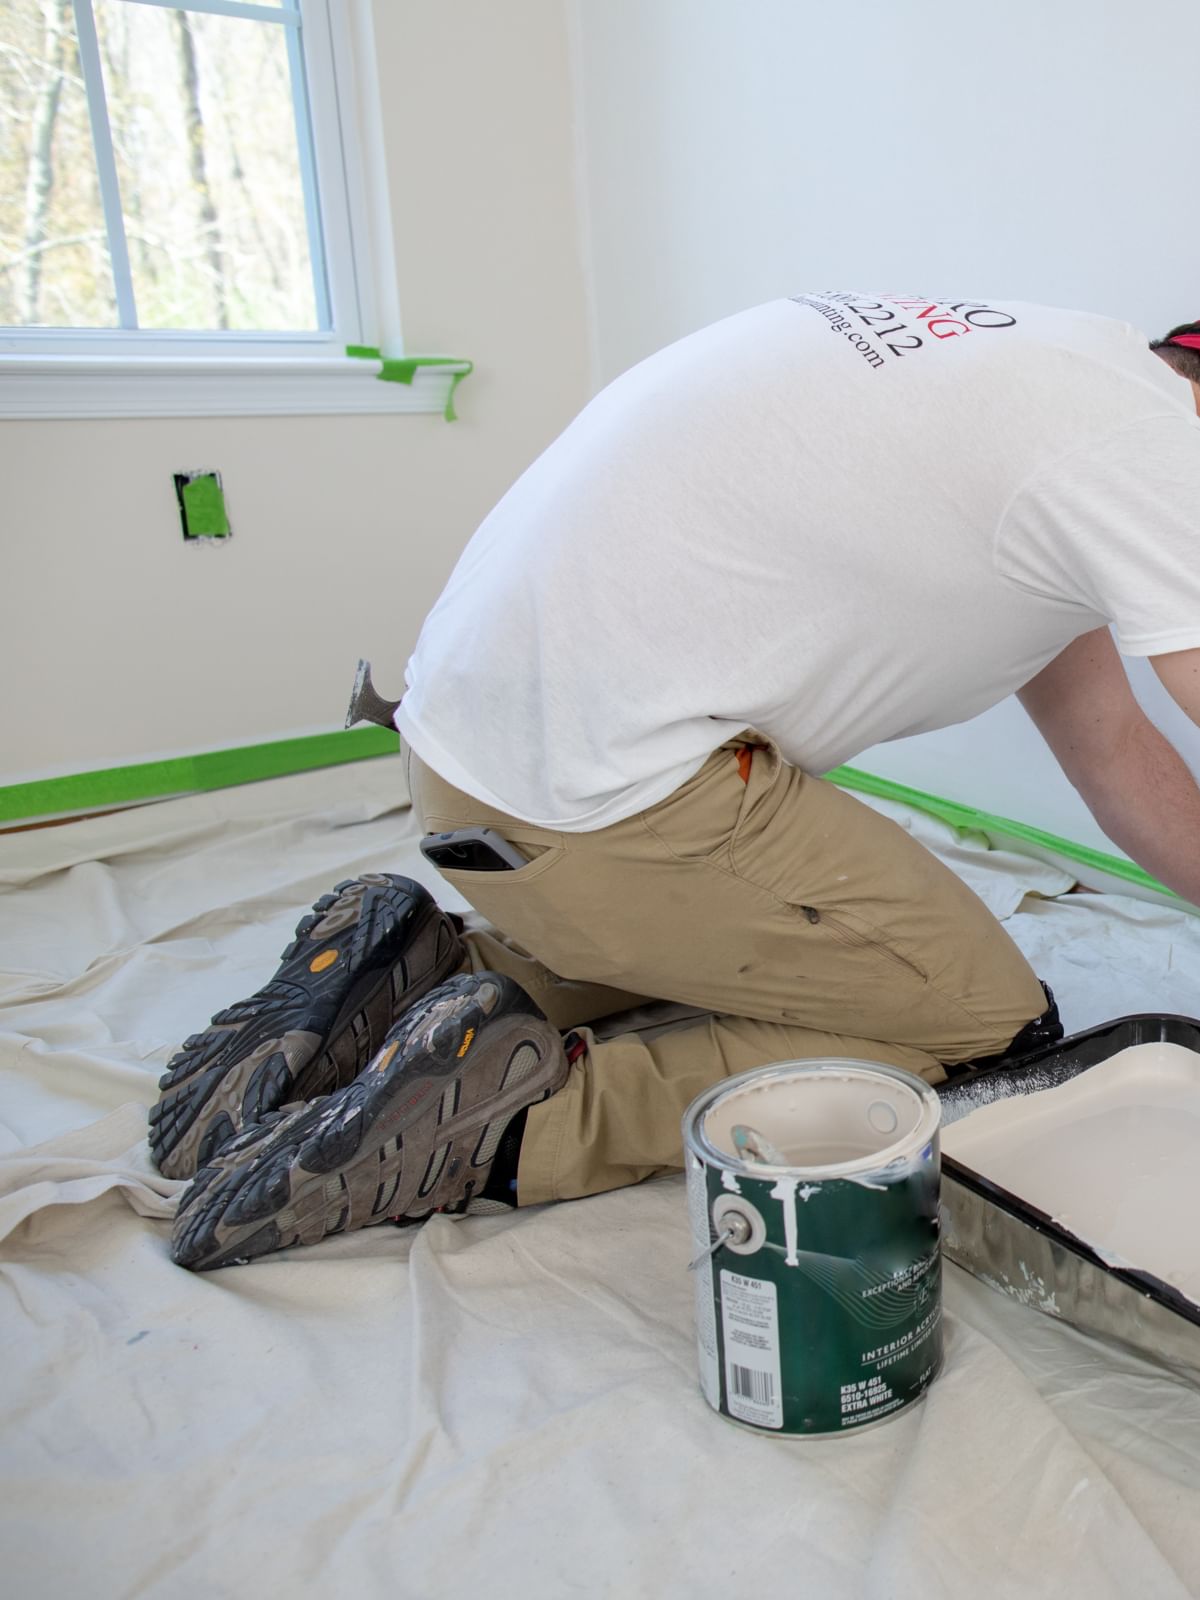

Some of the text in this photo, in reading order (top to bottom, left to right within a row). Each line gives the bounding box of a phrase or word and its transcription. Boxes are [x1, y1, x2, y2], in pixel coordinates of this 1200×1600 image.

[862, 1331, 913, 1362] INTERIOR
[876, 1327, 932, 1370] LIFETIME LIMITED
[840, 1375, 882, 1395] K35 W 451
[841, 1399, 868, 1413] EXTRA
[869, 1388, 893, 1406] WHITE
